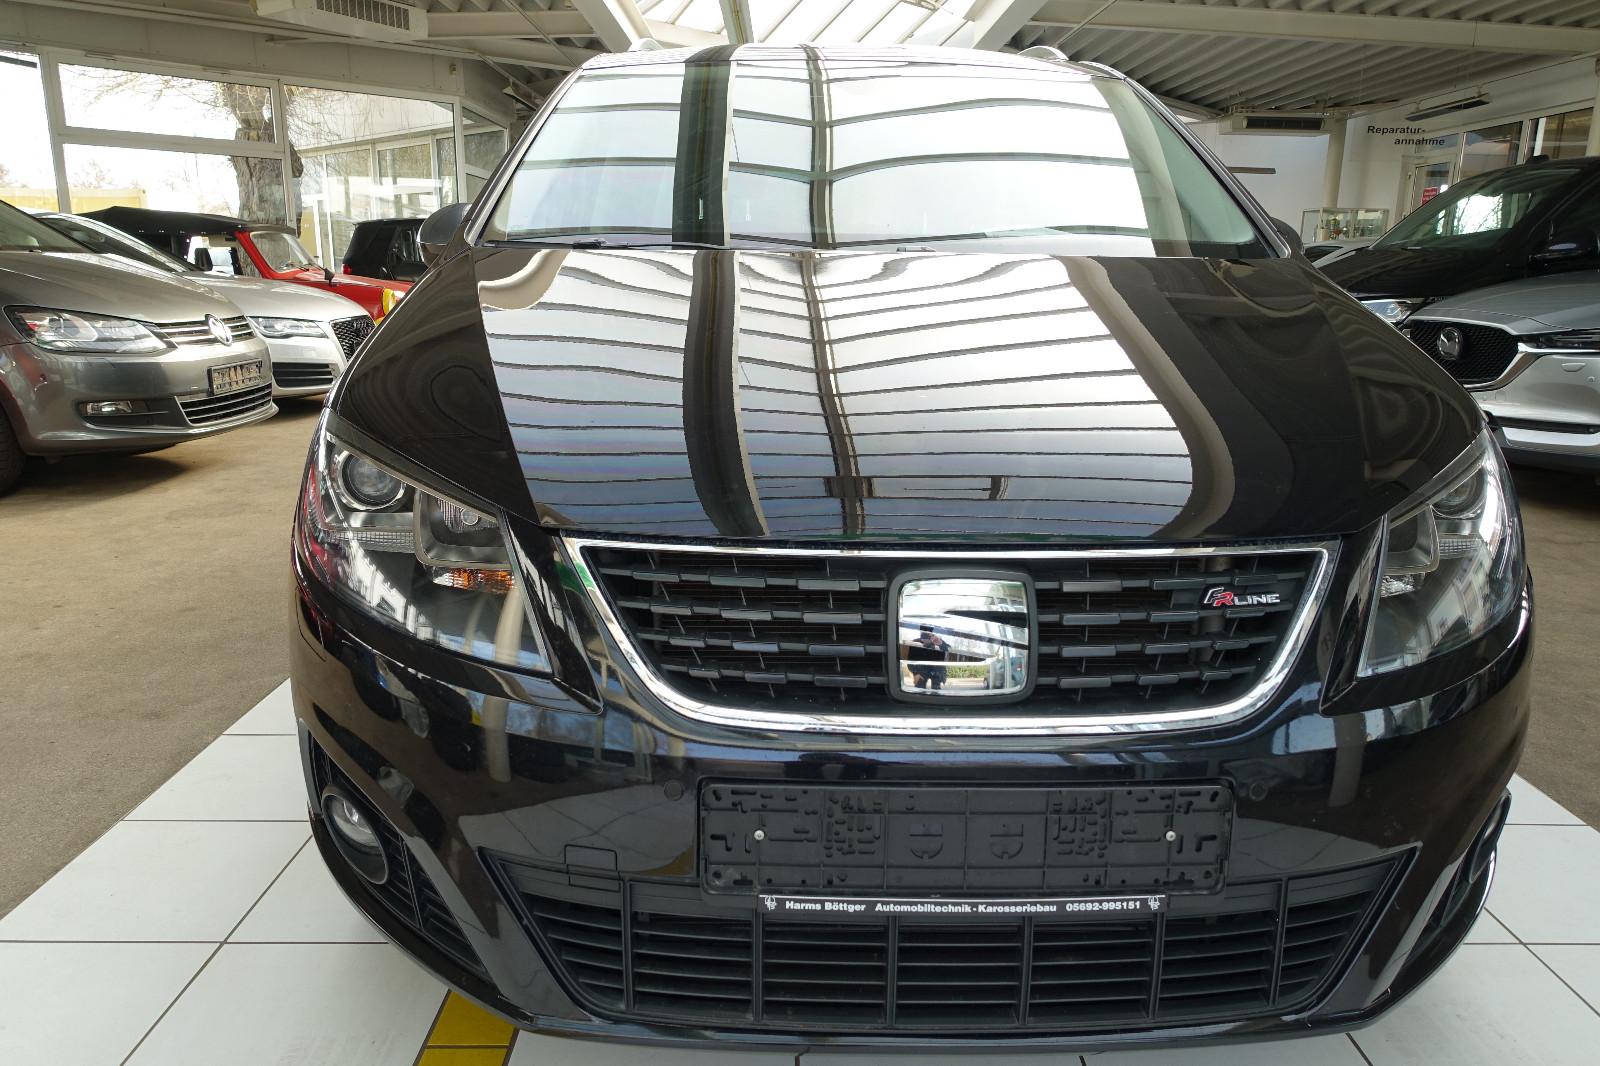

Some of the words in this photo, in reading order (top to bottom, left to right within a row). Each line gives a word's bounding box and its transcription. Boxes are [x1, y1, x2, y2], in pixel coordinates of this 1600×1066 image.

[1367, 125, 1426, 135] Reparatur-
[1394, 137, 1445, 146] annahme
[785, 900, 822, 911] Harms
[824, 901, 866, 912] Böttger
[1065, 900, 1141, 912] 05692-995151
